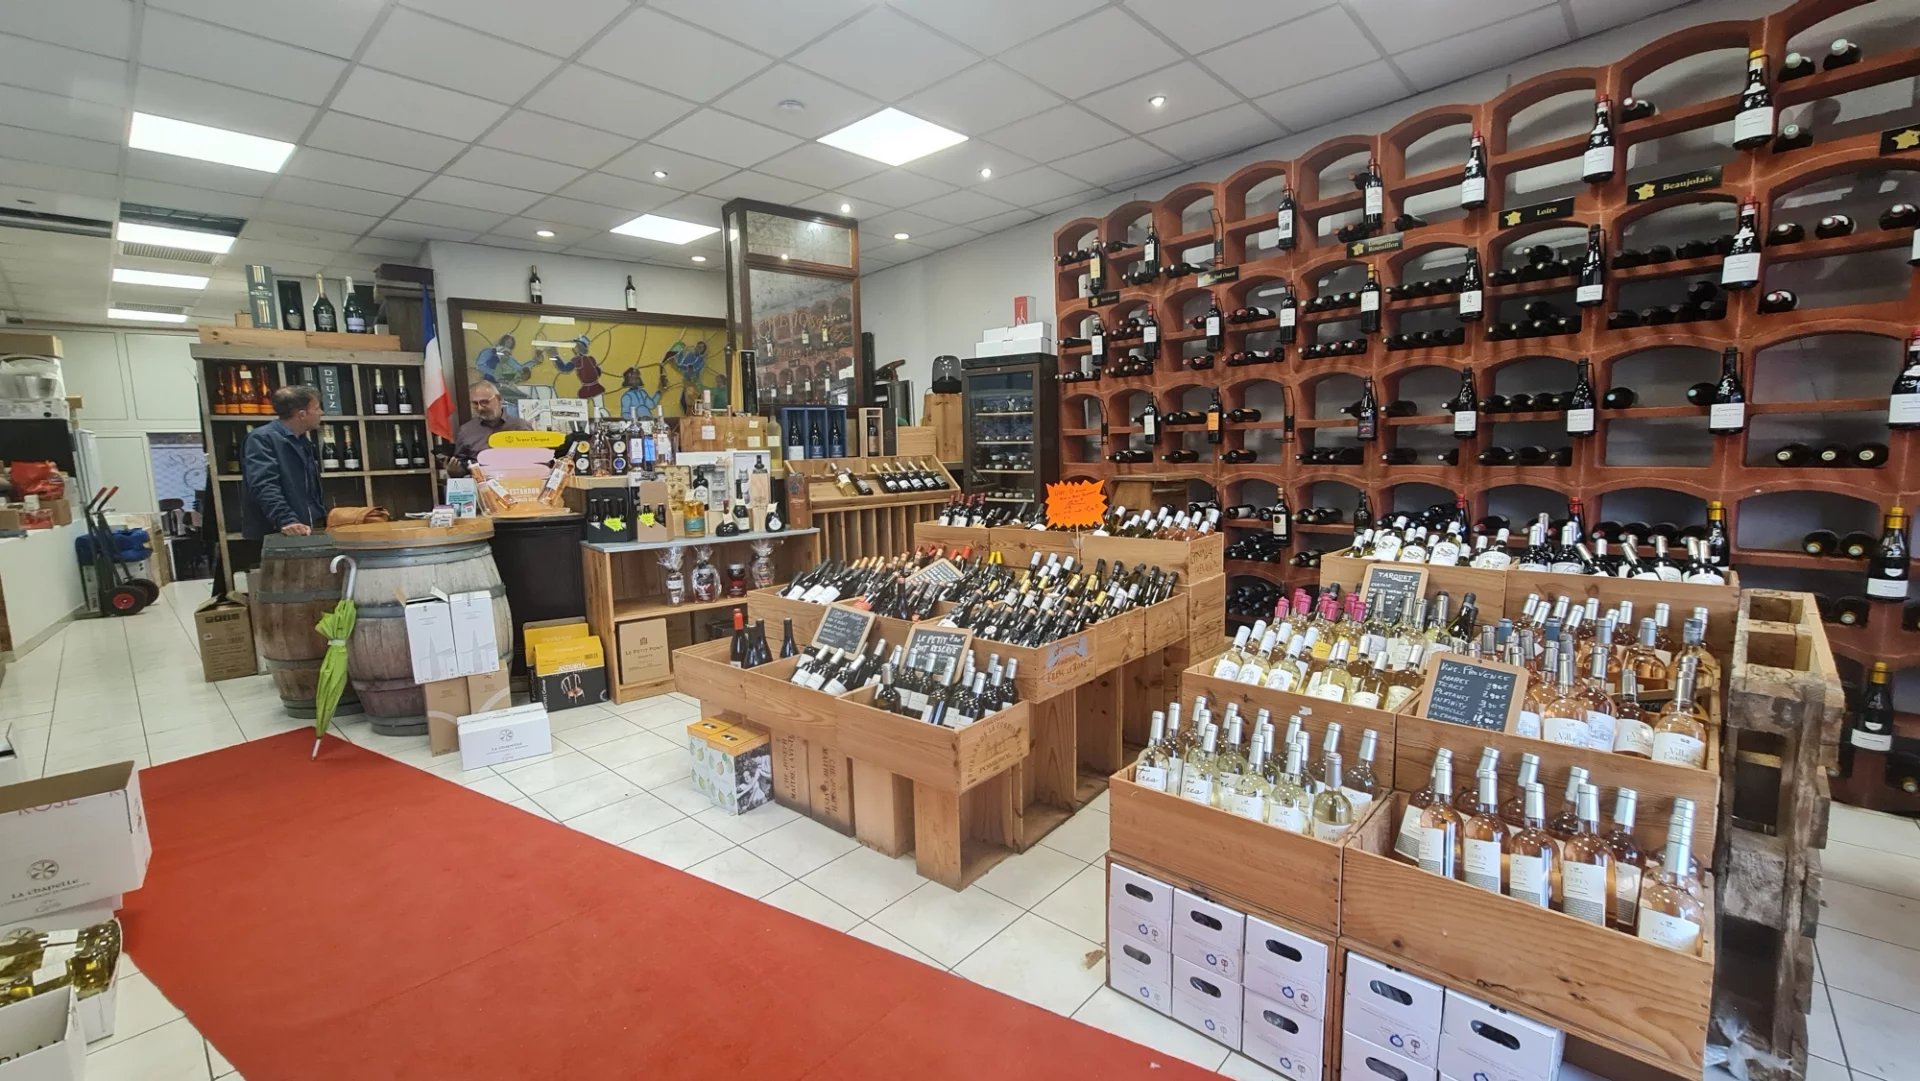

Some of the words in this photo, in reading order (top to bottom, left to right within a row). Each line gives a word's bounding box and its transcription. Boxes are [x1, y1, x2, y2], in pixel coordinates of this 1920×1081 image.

[1662, 175, 1713, 191] Beaujolais
[1536, 206, 1557, 216] Loire
[324, 369, 337, 408] DEUTZ
[917, 634, 926, 642] LE
[926, 635, 948, 644] PETIT
[1463, 666, 1511, 681] PROVENCE
